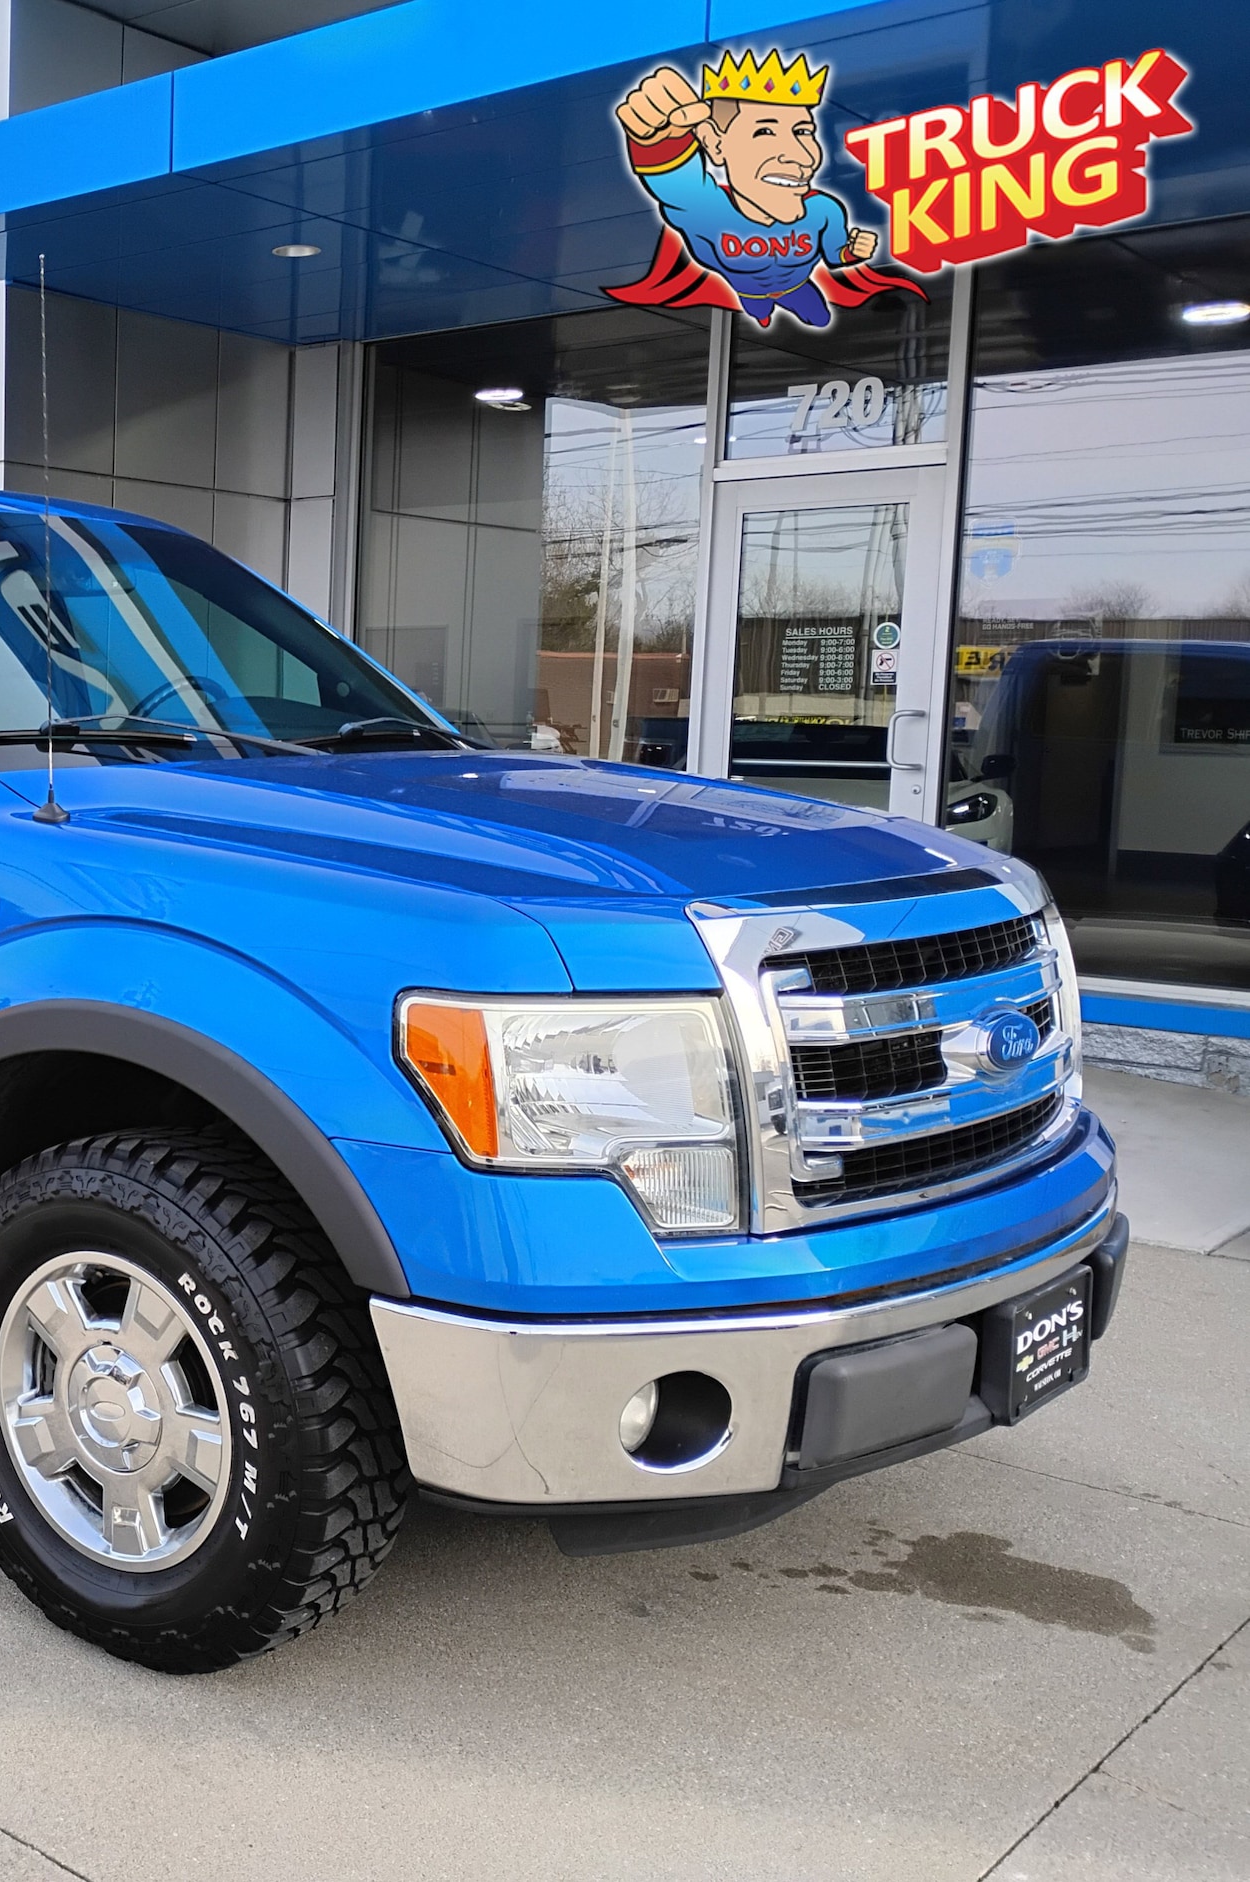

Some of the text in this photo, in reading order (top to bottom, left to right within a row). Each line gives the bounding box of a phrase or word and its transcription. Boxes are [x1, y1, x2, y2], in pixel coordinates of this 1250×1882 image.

[787, 376, 885, 432] 720
[782, 639, 808, 647] Monday
[786, 626, 853, 636] SALES HOURS
[780, 669, 800, 677] Friday
[1180, 727, 1224, 740] TREVOR
[1002, 1023, 1034, 1060] Ford
[1016, 1300, 1085, 1355] DON'S
[1037, 1336, 1060, 1360] GMC
[1026, 1348, 1073, 1382] CORVETTE
[177, 1271, 259, 1541] ROCK 767 M/T
